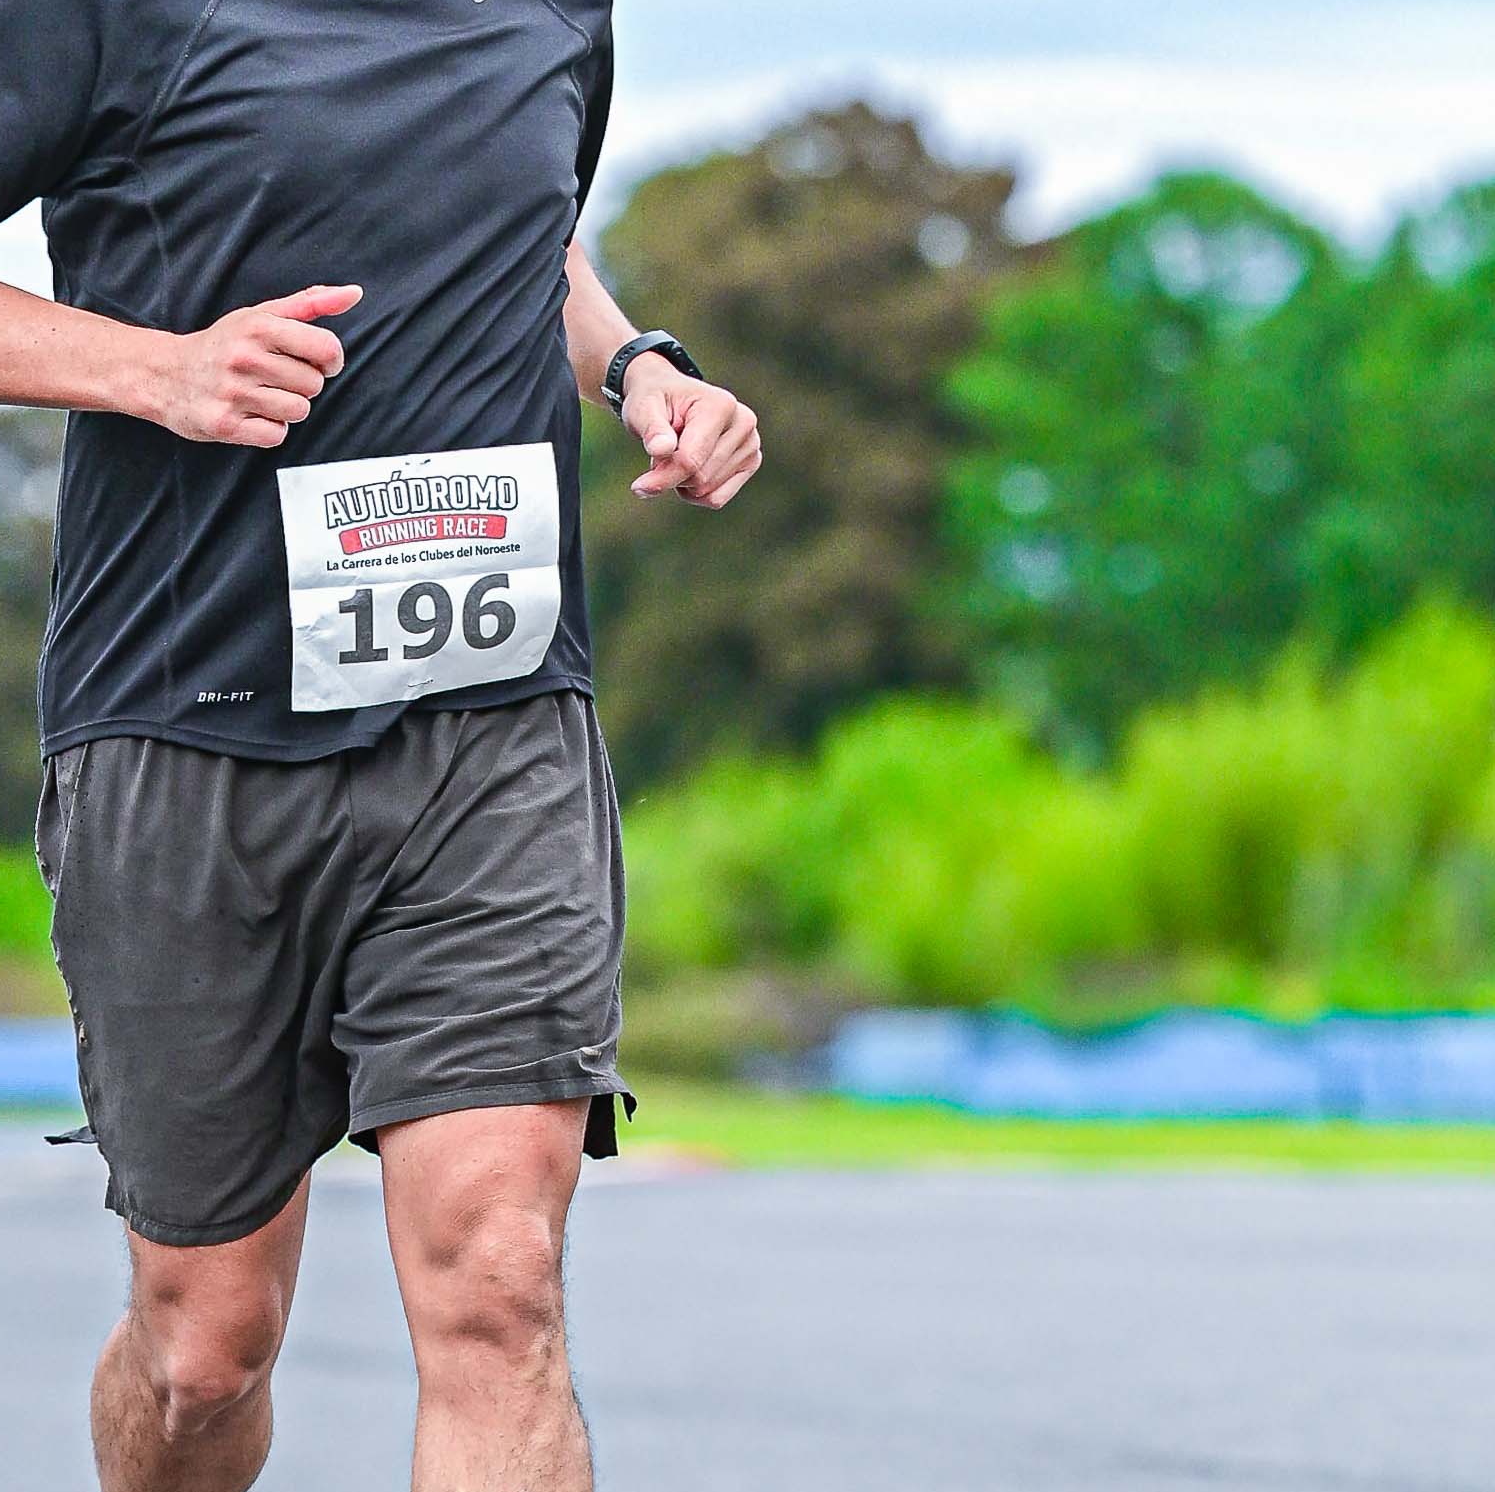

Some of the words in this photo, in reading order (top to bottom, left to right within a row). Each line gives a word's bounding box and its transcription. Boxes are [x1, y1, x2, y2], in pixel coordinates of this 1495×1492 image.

[324, 470, 518, 529] AUTÓDROMO
[358, 519, 437, 548] RUNNING
[443, 517, 489, 537] RACE
[326, 561, 339, 572] La
[341, 557, 382, 570] Carrera
[385, 554, 399, 565] de
[401, 552, 417, 564] los
[419, 548, 454, 562] Clubes
[456, 545, 473, 557] del
[475, 542, 521, 555] Noroeste
[338, 573, 516, 665] 196
[197, 691, 254, 702] DRI-FIT
